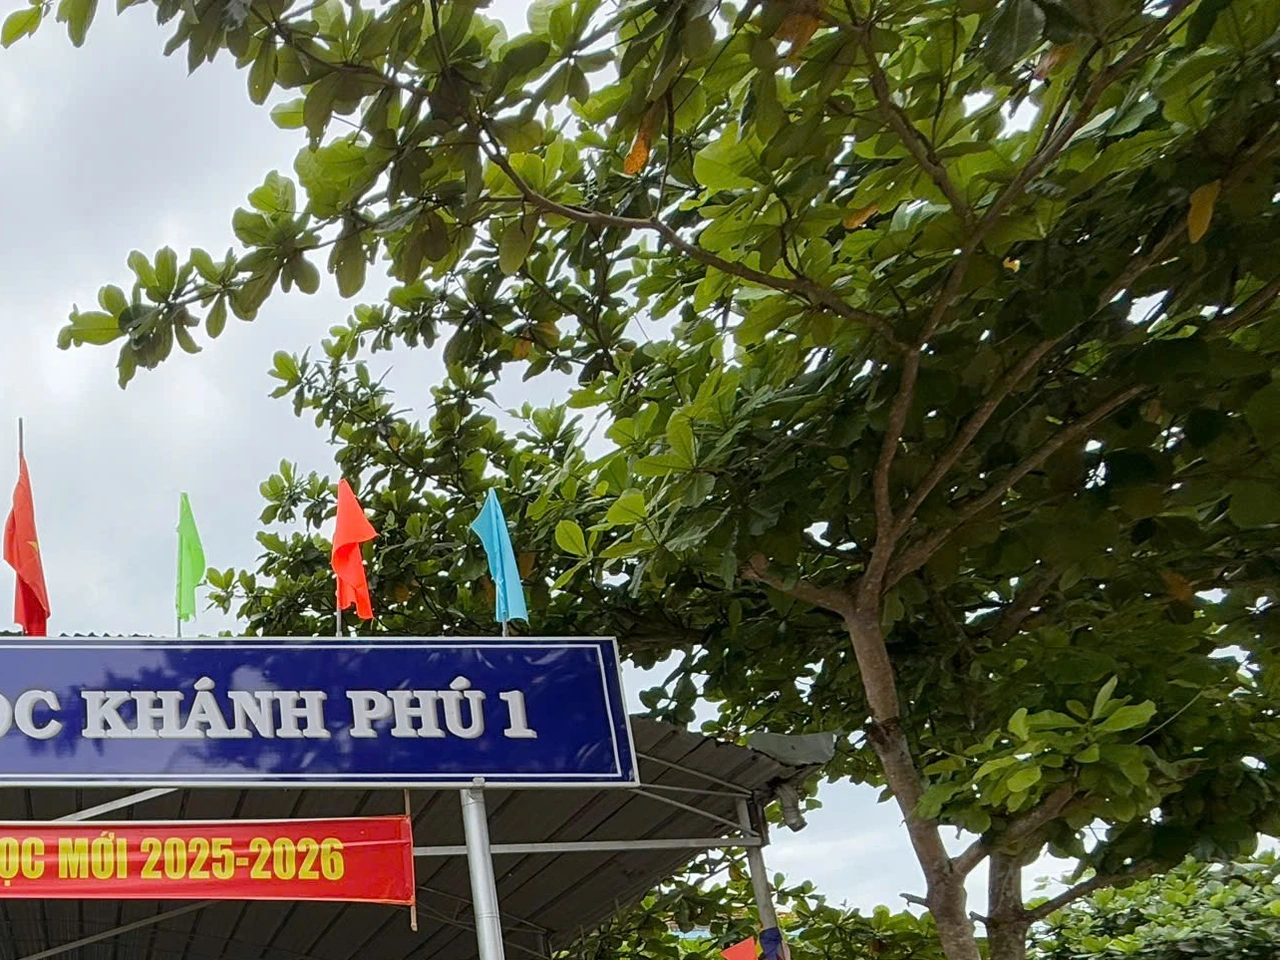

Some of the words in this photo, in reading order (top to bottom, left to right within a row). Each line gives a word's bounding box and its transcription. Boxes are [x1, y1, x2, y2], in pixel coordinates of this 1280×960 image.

[80, 675, 333, 740] KHÁNH
[346, 675, 487, 740] PHÚ
[499, 689, 538, 740] 1
[57, 831, 128, 879] MỚI
[140, 836, 345, 881] 2025-2026
